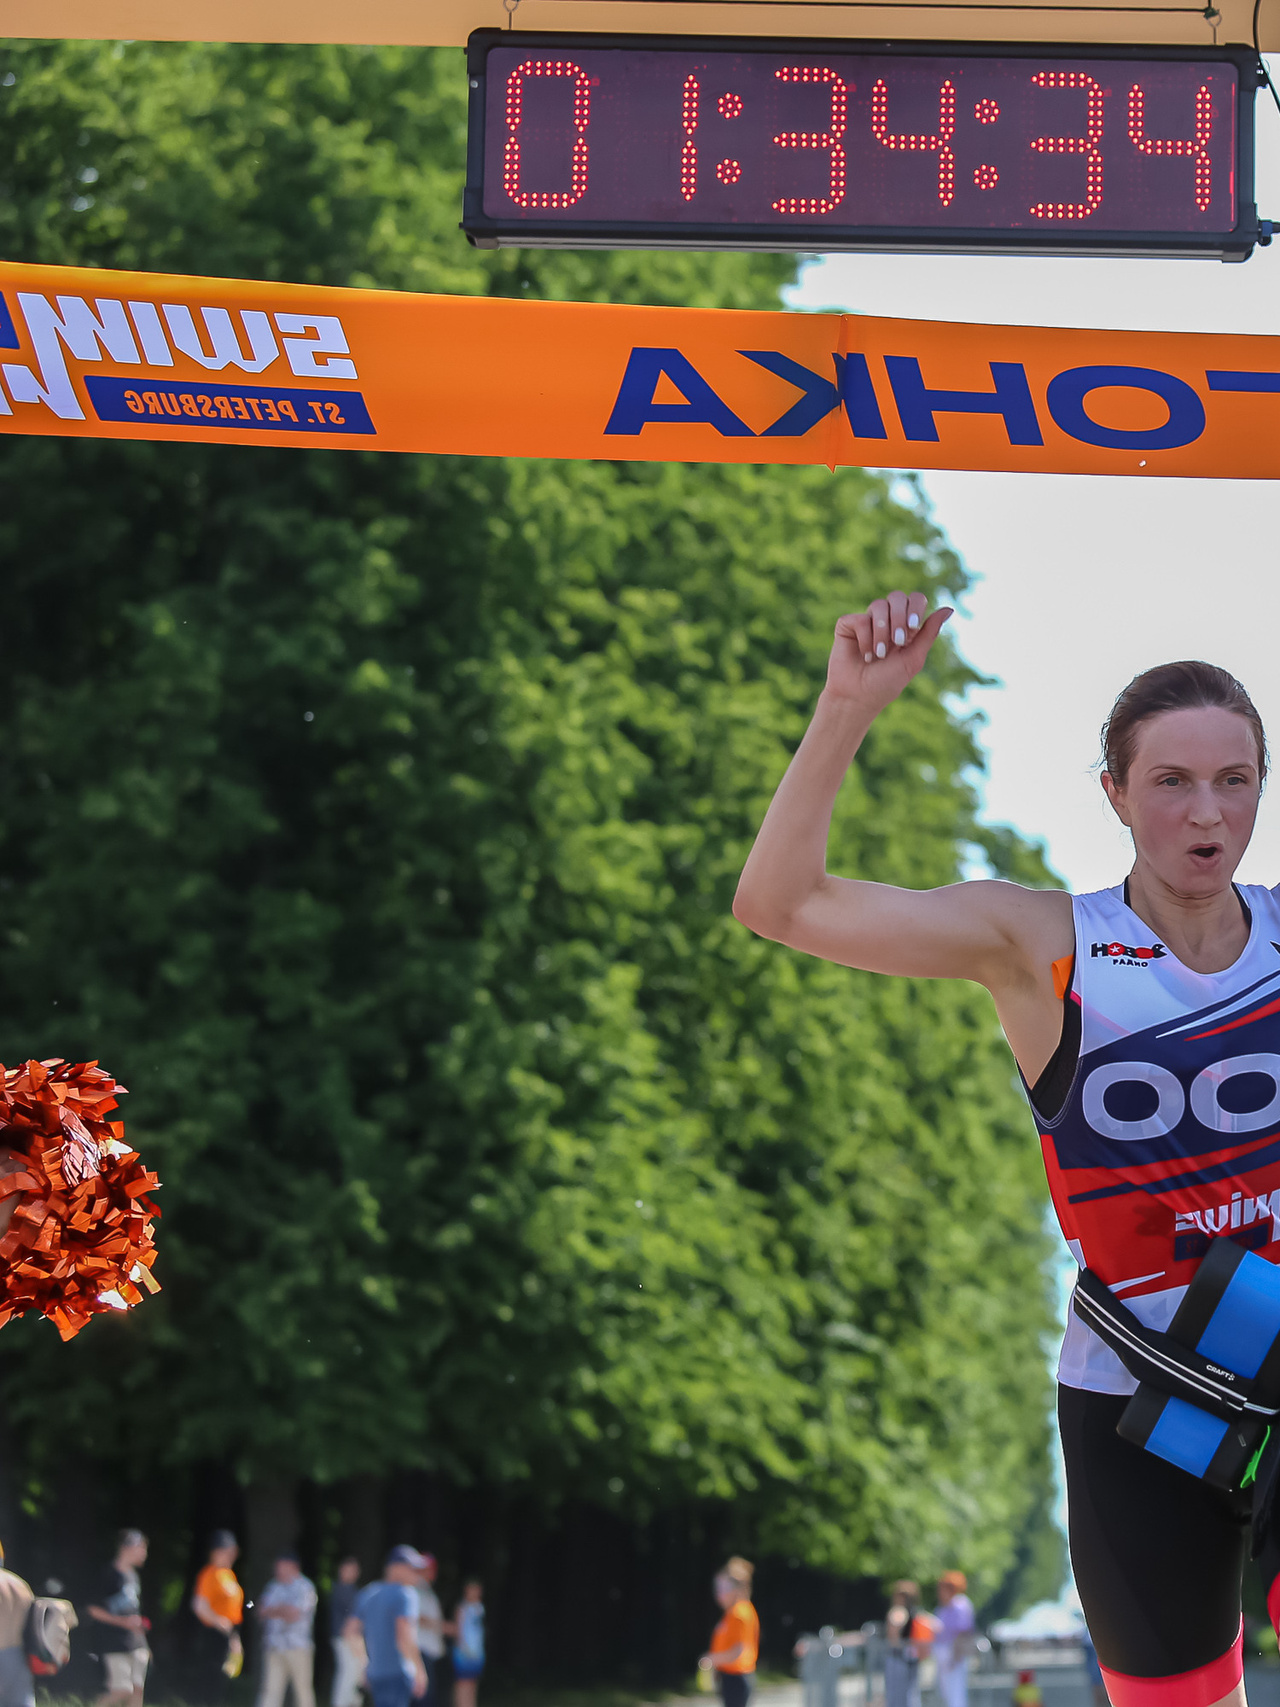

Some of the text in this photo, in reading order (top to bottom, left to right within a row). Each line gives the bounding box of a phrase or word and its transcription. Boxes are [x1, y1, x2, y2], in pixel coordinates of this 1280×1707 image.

[503, 60, 1211, 219] 01:34:34
[1112, 958, 1149, 968] РАДИО
[1206, 1364, 1231, 1379] CRAFT
